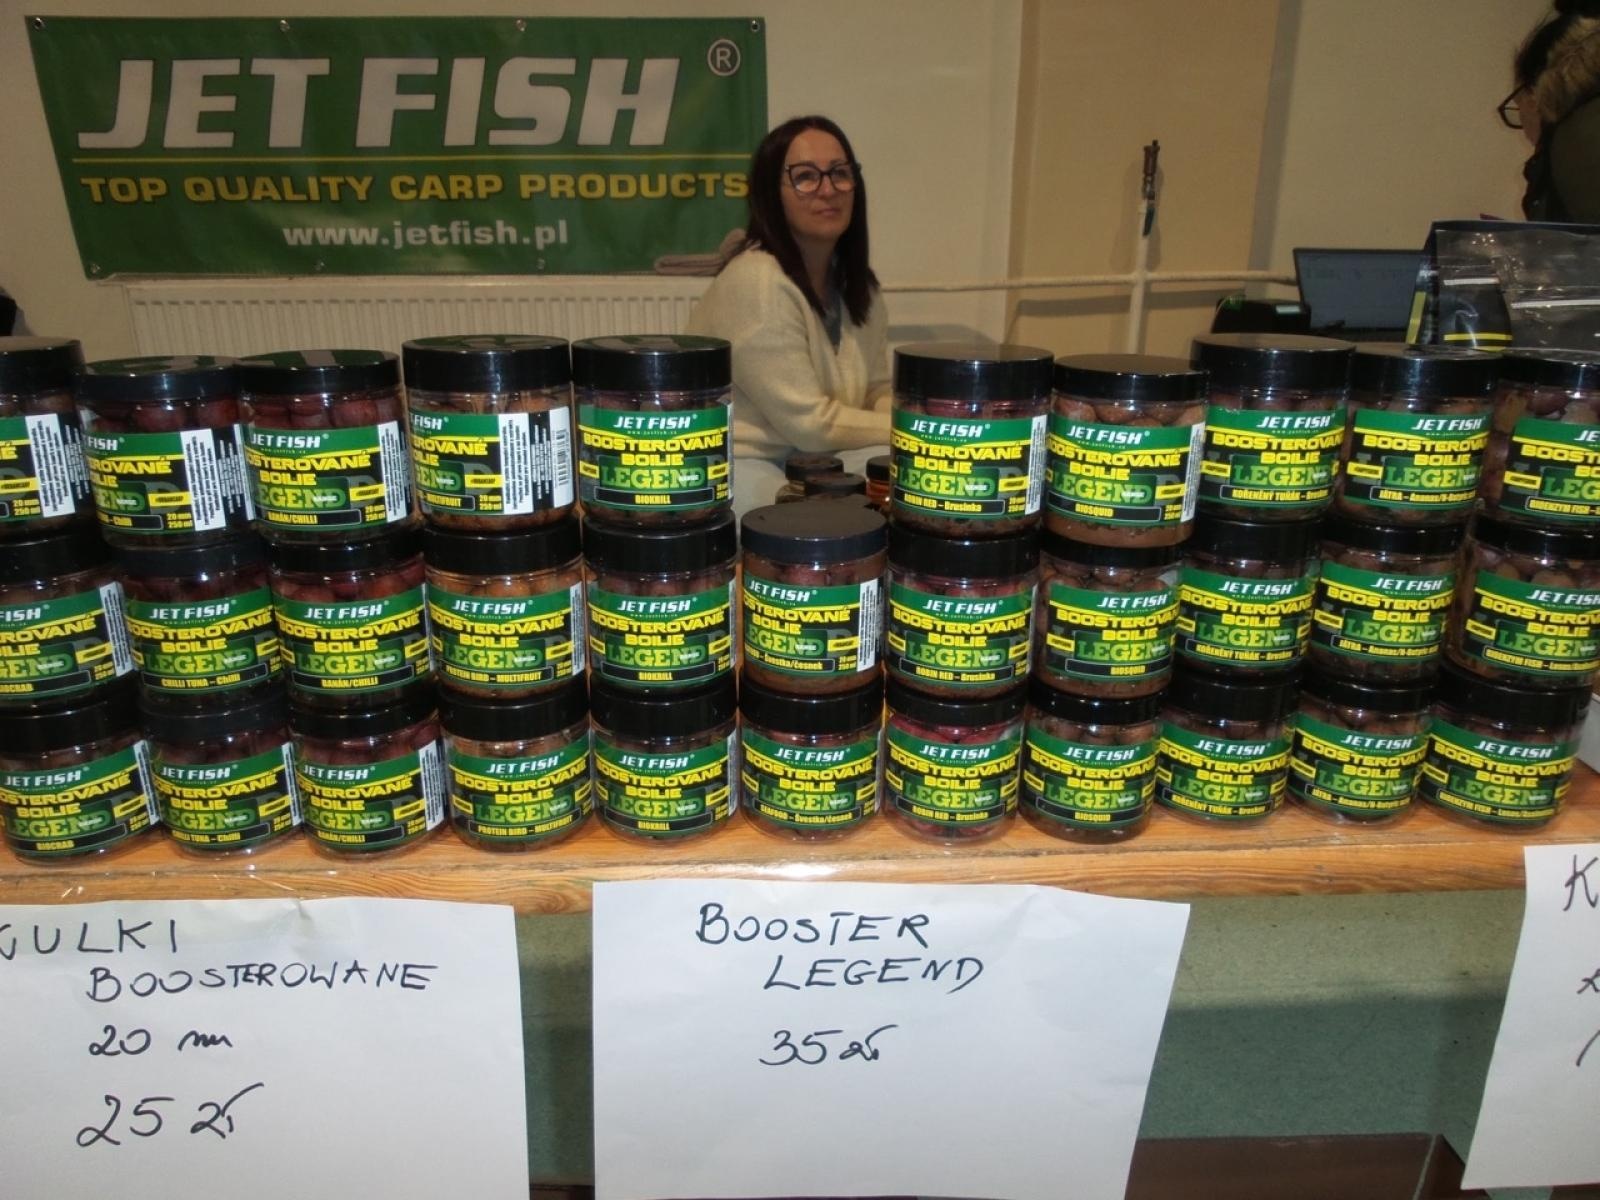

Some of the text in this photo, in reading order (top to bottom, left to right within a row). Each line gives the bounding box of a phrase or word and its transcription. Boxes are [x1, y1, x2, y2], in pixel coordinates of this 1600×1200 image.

[78, 58, 330, 149] JET
[355, 58, 680, 148] FISH
[81, 172, 749, 203] TOP QUALITY CARP PRODUCTS
[282, 220, 568, 248] www.jetfish.pl
[414, 415, 442, 430] FISH
[614, 416, 691, 429] JET FISH
[910, 420, 983, 438] JET FISH
[1256, 416, 1331, 428] JET FISH
[1411, 419, 1482, 430] JET FISH
[251, 433, 320, 448] JET FISH
[1067, 426, 1142, 444] JET FISH
[87, 437, 118, 451] FISH
[621, 453, 684, 466] BOILIE
[914, 456, 972, 474] BOILIE
[1260, 452, 1320, 464] BOILIE
[1413, 454, 1471, 466] BOILIE
[260, 470, 317, 485] BOILIE
[1070, 461, 1130, 481] BOILIE
[256, 488, 347, 508] EGEND
[749, 580, 811, 602] JET FISH
[1219, 581, 1293, 595] JET FISH
[1370, 578, 1443, 591] JET FISH
[1097, 594, 1167, 609] JET FISH
[1526, 590, 1564, 603] JET
[150, 603, 229, 620] JET FISH
[304, 604, 382, 620] JET FISH
[452, 600, 526, 615] JET FISH
[617, 600, 691, 613] JET FISH
[922, 600, 997, 614] JET FISH
[752, 613, 801, 635] BOILIE
[1221, 613, 1282, 627] BOILIE
[1372, 610, 1431, 623] BOILIE
[1102, 628, 1159, 641] BOILIE
[1527, 622, 1591, 637] BOILIE
[161, 638, 227, 653] BOILIE
[314, 639, 378, 653] BOILIE
[459, 634, 519, 648] BOILIE
[625, 634, 685, 646] BOILIE
[748, 625, 825, 656] EGEND
[928, 632, 988, 647] BOILIE
[1193, 740, 1266, 756] JET FISH
[1340, 735, 1413, 749] JET FISH
[1474, 741, 1553, 758] JET FISH
[774, 748, 845, 762] JET FISH
[920, 745, 991, 760] JET FISH
[1062, 747, 1136, 761] JET FISH
[486, 756, 559, 774] JET FISH
[619, 755, 689, 769] JET FISH
[5, 770, 82, 786] JET FISH
[161, 767, 231, 780] JET FISH
[304, 765, 369, 780] JET FISH
[1196, 769, 1254, 785] BOILIE
[1343, 764, 1401, 779] BOILIE
[1475, 770, 1539, 788] BOILIE
[779, 779, 836, 792] BOILIE
[924, 776, 981, 790] BOILIE
[1067, 777, 1125, 791] BOILIE
[495, 788, 555, 804] BOILIE
[625, 785, 682, 800] BOILIE
[16, 803, 82, 818] BOILIE
[170, 798, 228, 811] BOILIE
[310, 796, 365, 811] BOILIE
[8, 811, 111, 838] EGEND
[168, 809, 256, 830] EGEND
[308, 808, 390, 830] EGEND
[695, 902, 930, 949] BOOSTER
[86, 960, 439, 1003] BOOSTEROWANE
[763, 954, 984, 995] LEGEND
[89, 1024, 151, 1056] 20
[76, 1095, 176, 1147] 25
